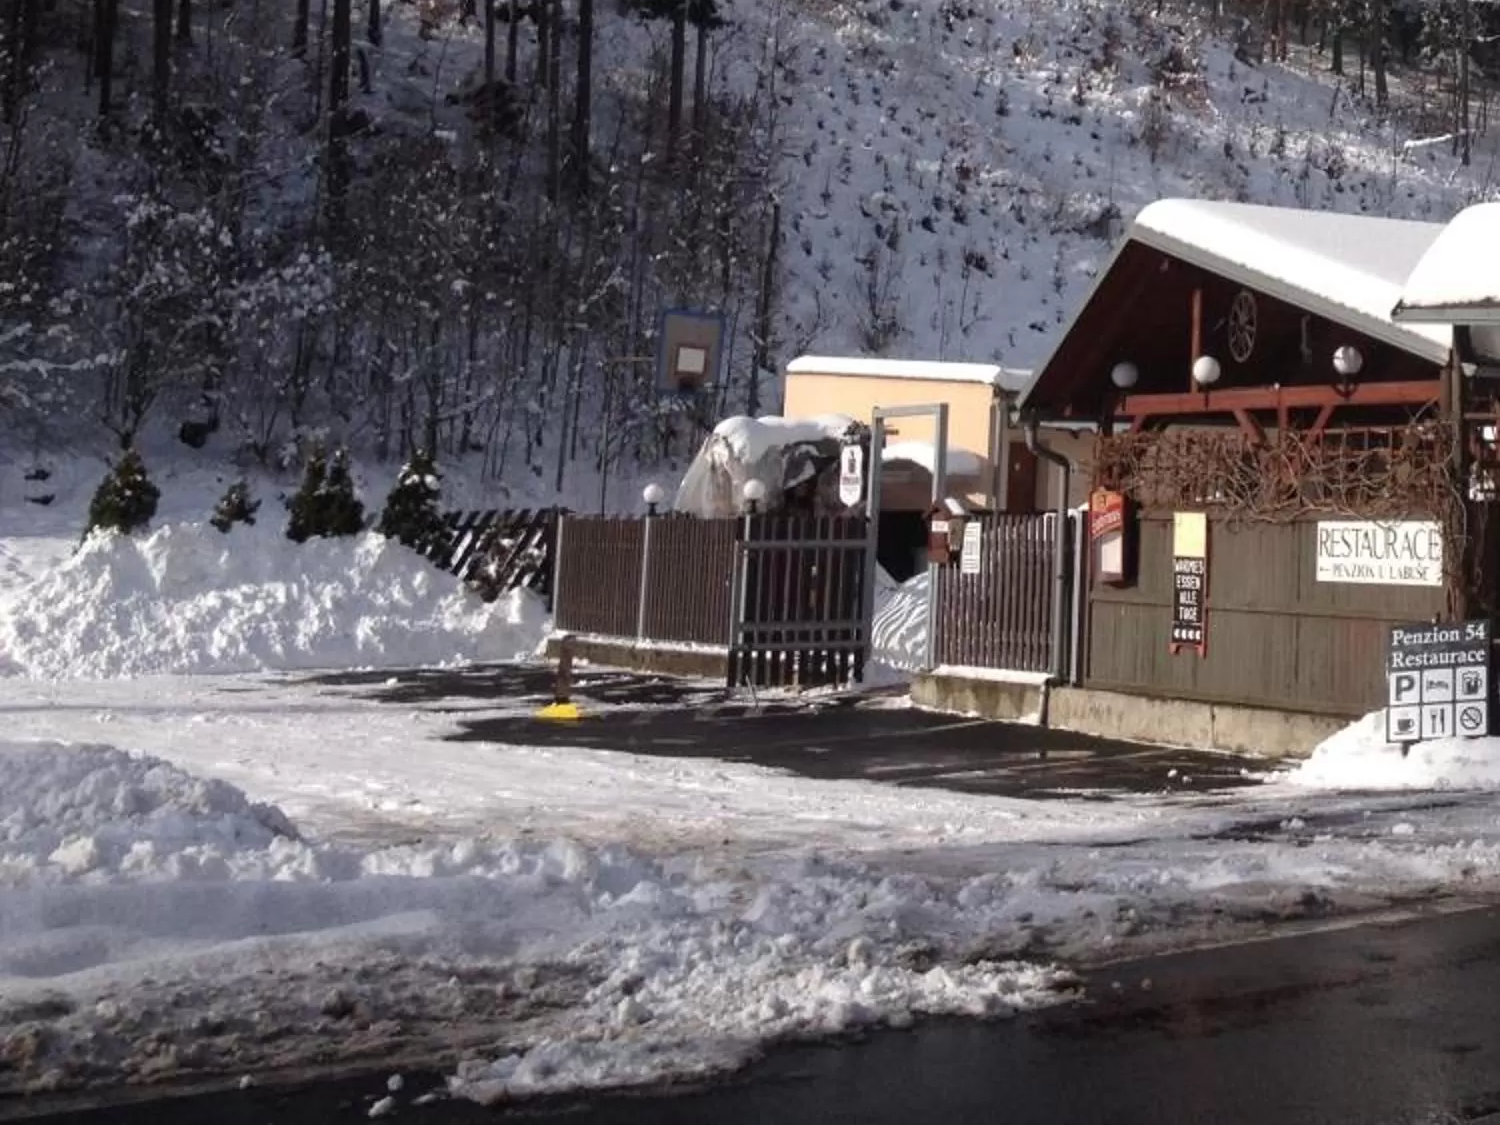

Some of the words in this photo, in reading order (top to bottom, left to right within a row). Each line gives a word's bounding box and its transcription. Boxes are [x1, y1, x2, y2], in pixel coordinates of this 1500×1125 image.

[1319, 526, 1440, 561] RESTAURACE
[1176, 574, 1200, 589] ESSEN
[1392, 627, 1460, 646] Penzion
[1465, 623, 1485, 641] 54
[1392, 649, 1486, 668] Restaurace
[1395, 674, 1415, 701] P
